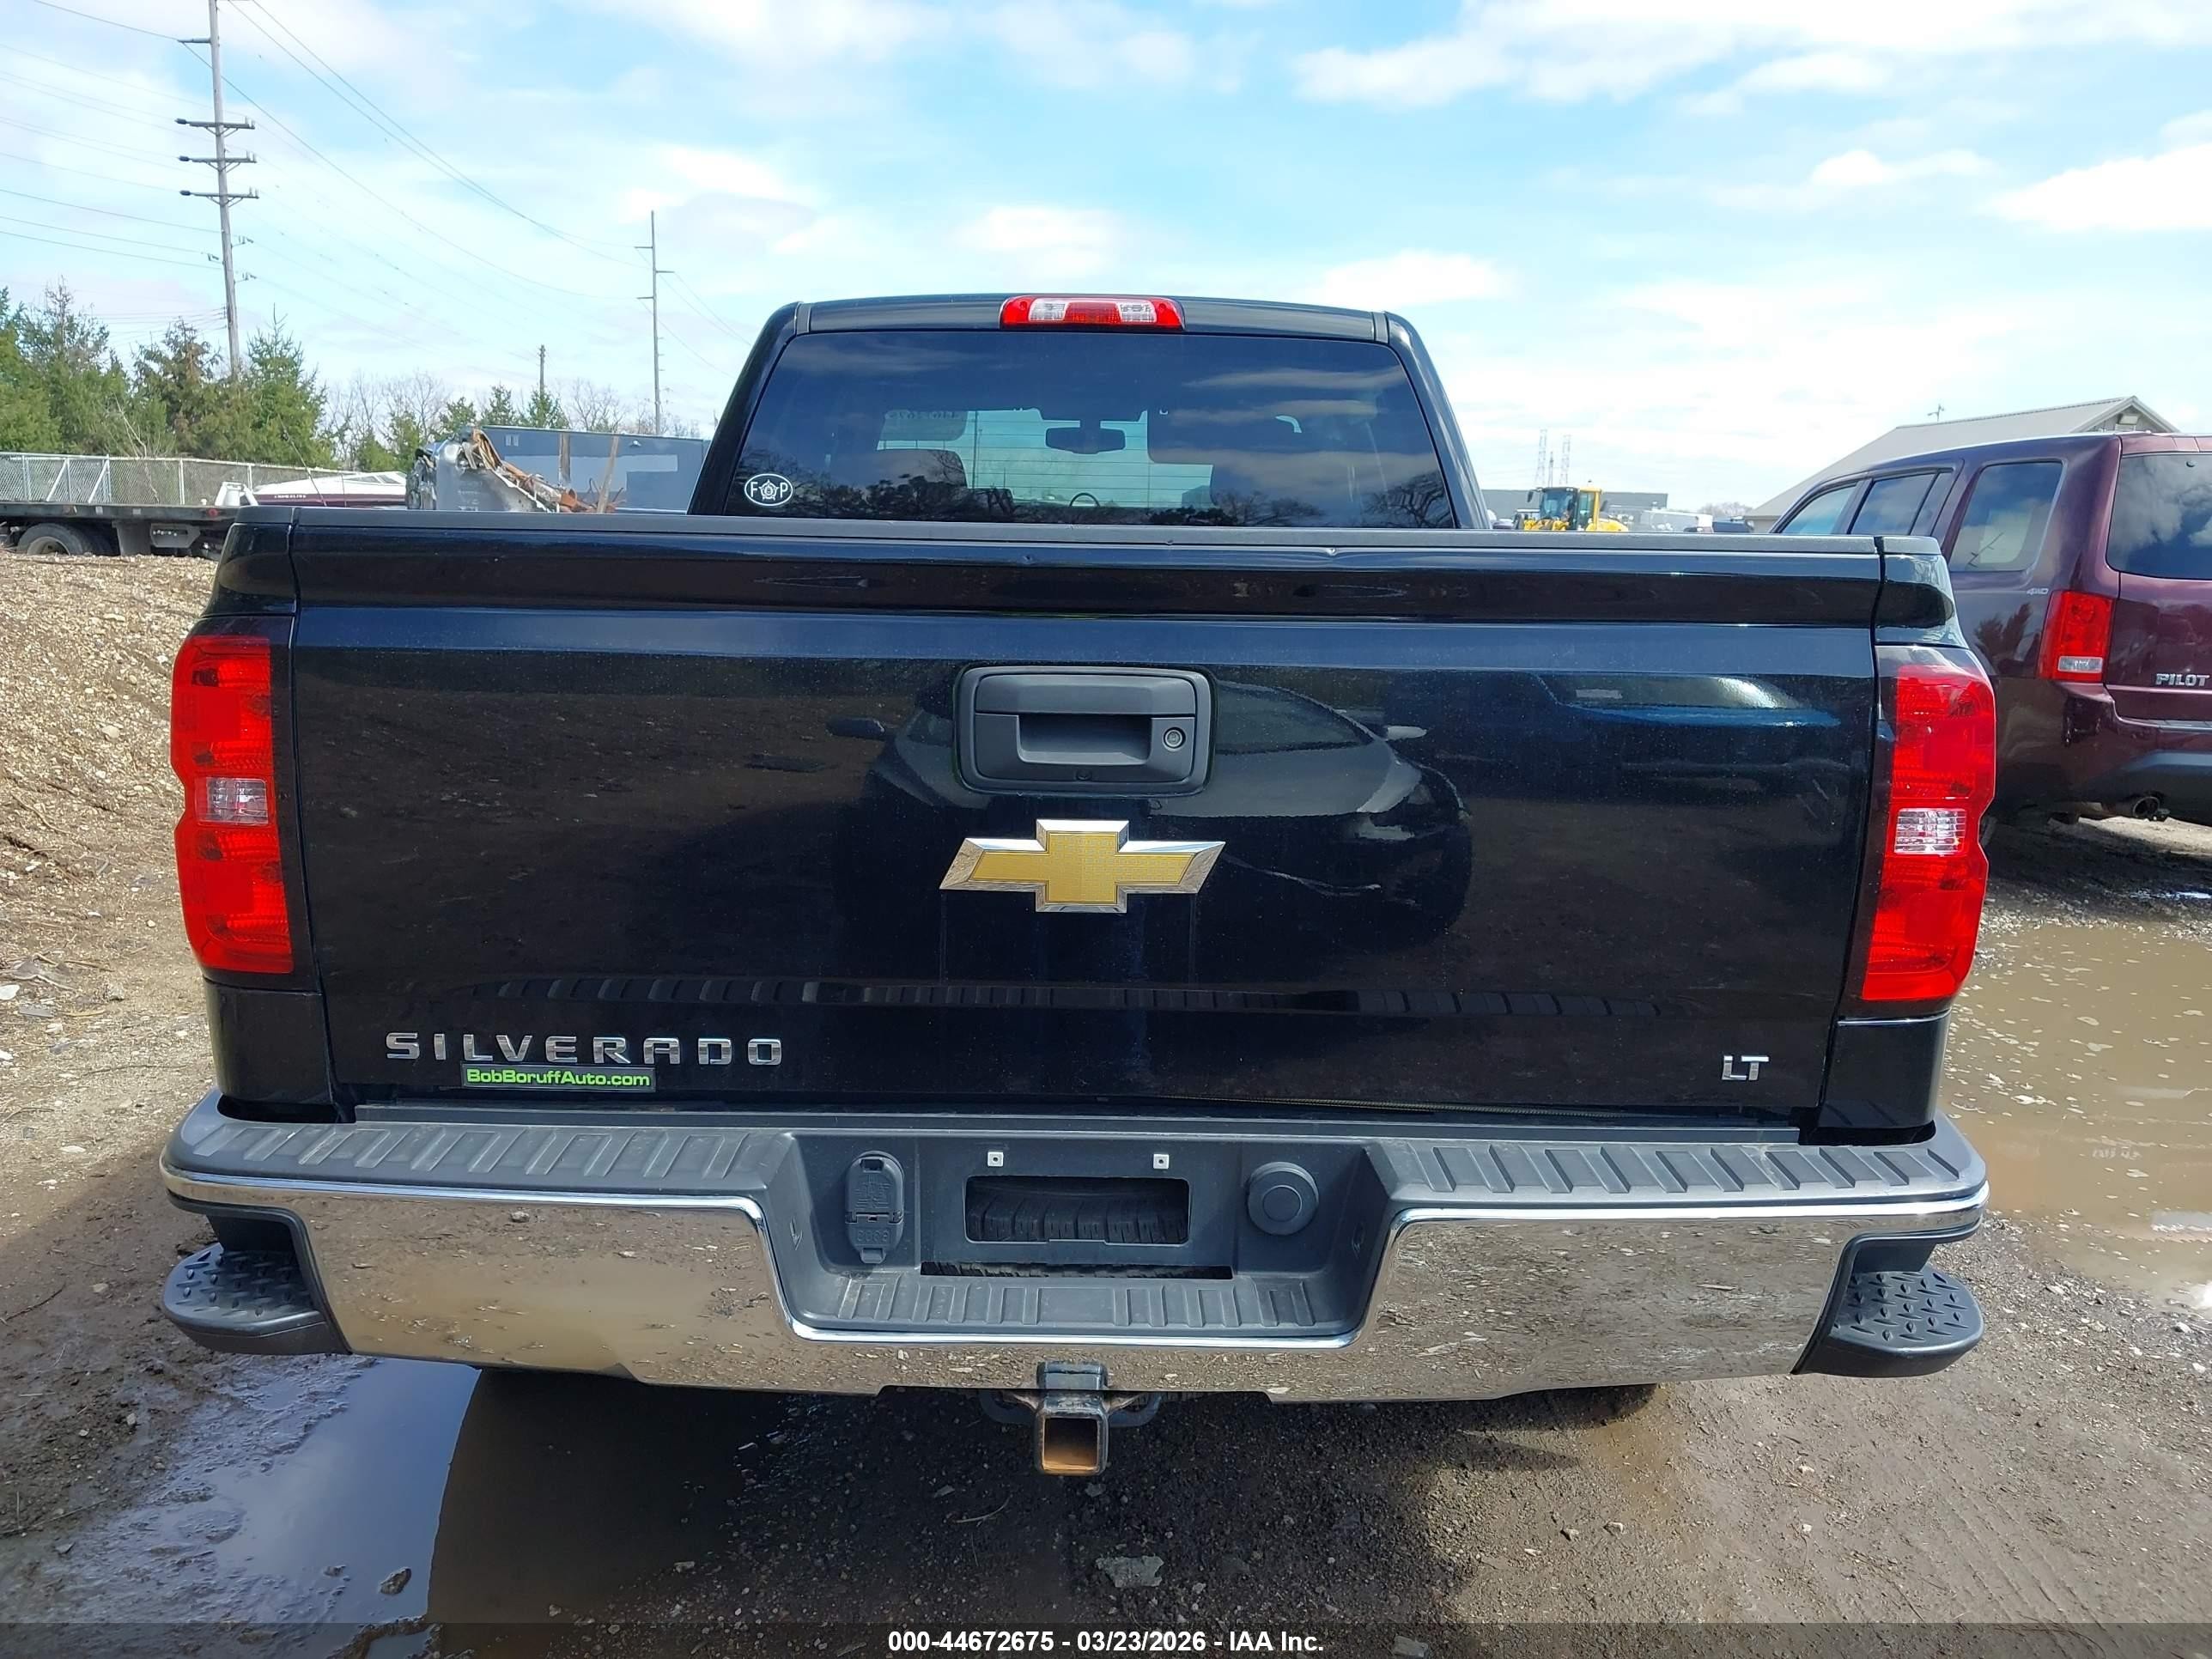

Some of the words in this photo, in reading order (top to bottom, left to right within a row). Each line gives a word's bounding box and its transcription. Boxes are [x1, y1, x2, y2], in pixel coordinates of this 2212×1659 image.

[2155, 673, 2210, 687] PILOT
[386, 1032, 783, 1066] SILVERADO
[465, 1067, 651, 1087] BobBoruffAuto.com
[1721, 1055, 1770, 1080] LT
